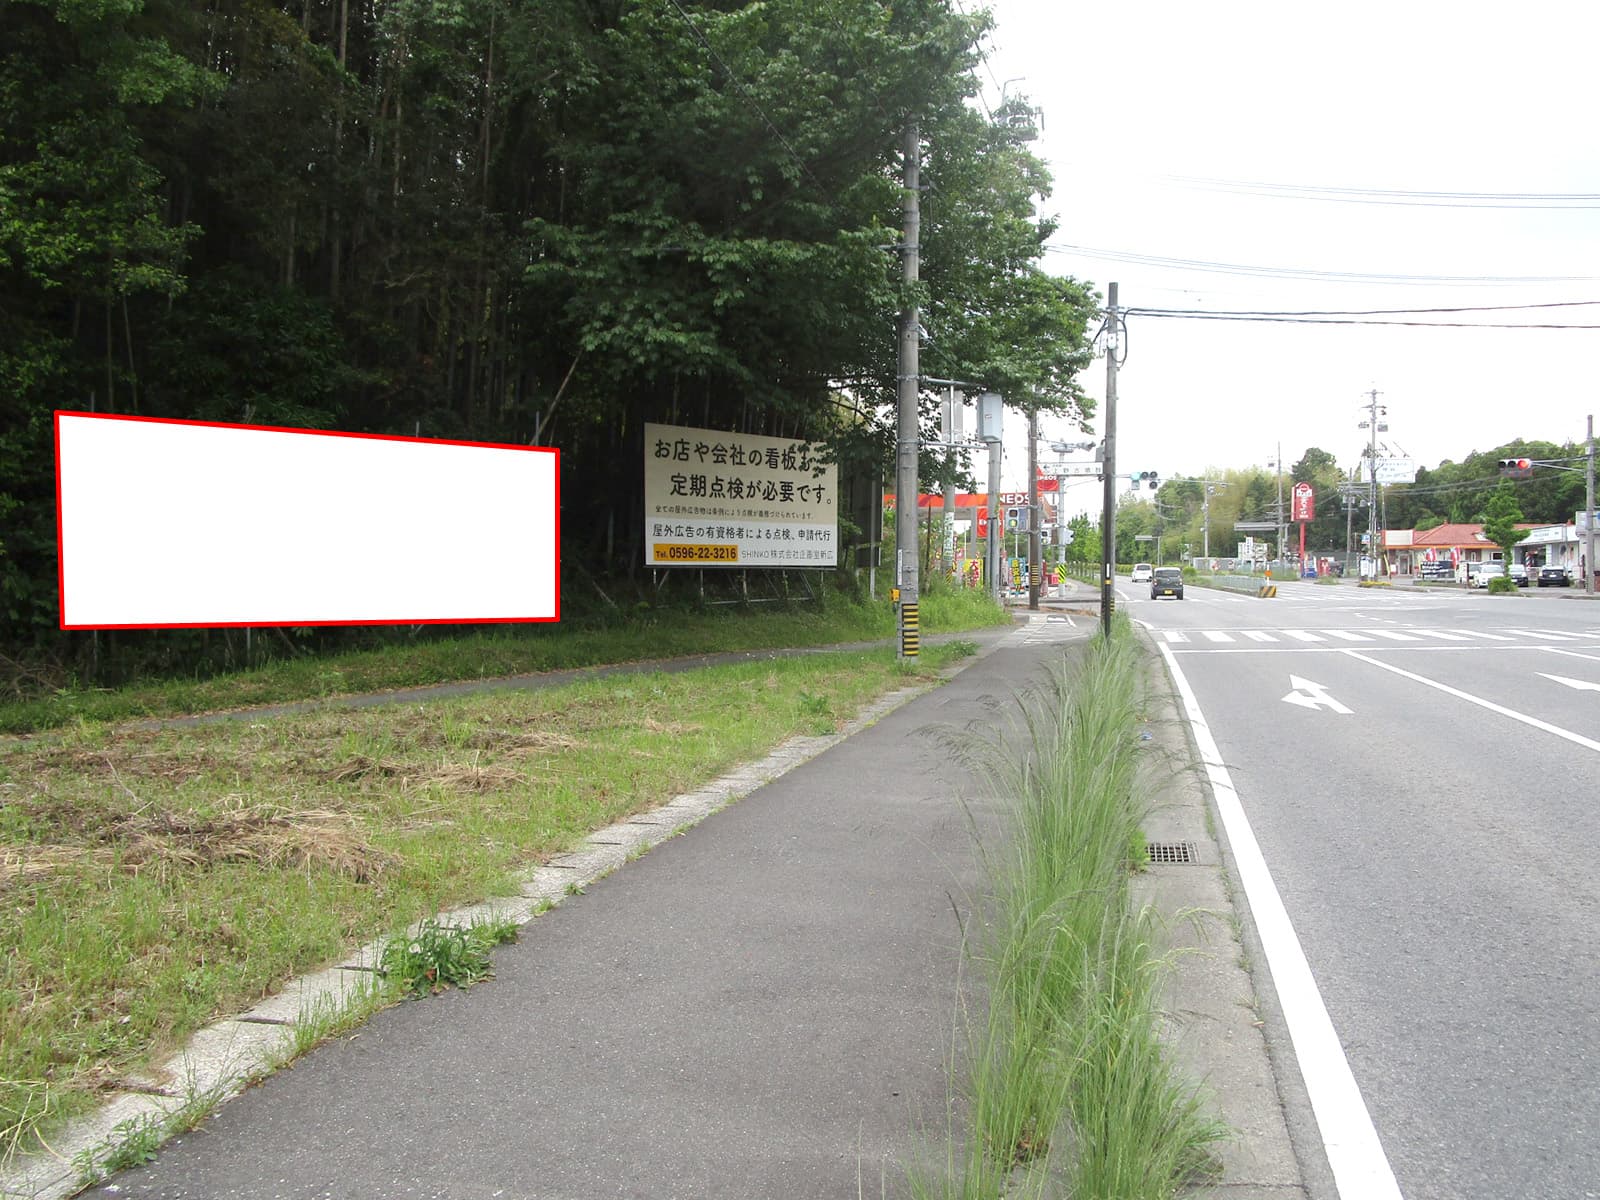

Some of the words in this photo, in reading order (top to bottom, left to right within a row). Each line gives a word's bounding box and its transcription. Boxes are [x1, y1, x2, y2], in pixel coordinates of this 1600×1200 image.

[670, 473, 832, 505] 定期点検が必要です。
[999, 494, 1029, 504] NEOS
[669, 547, 737, 559] 0596-22-3216
